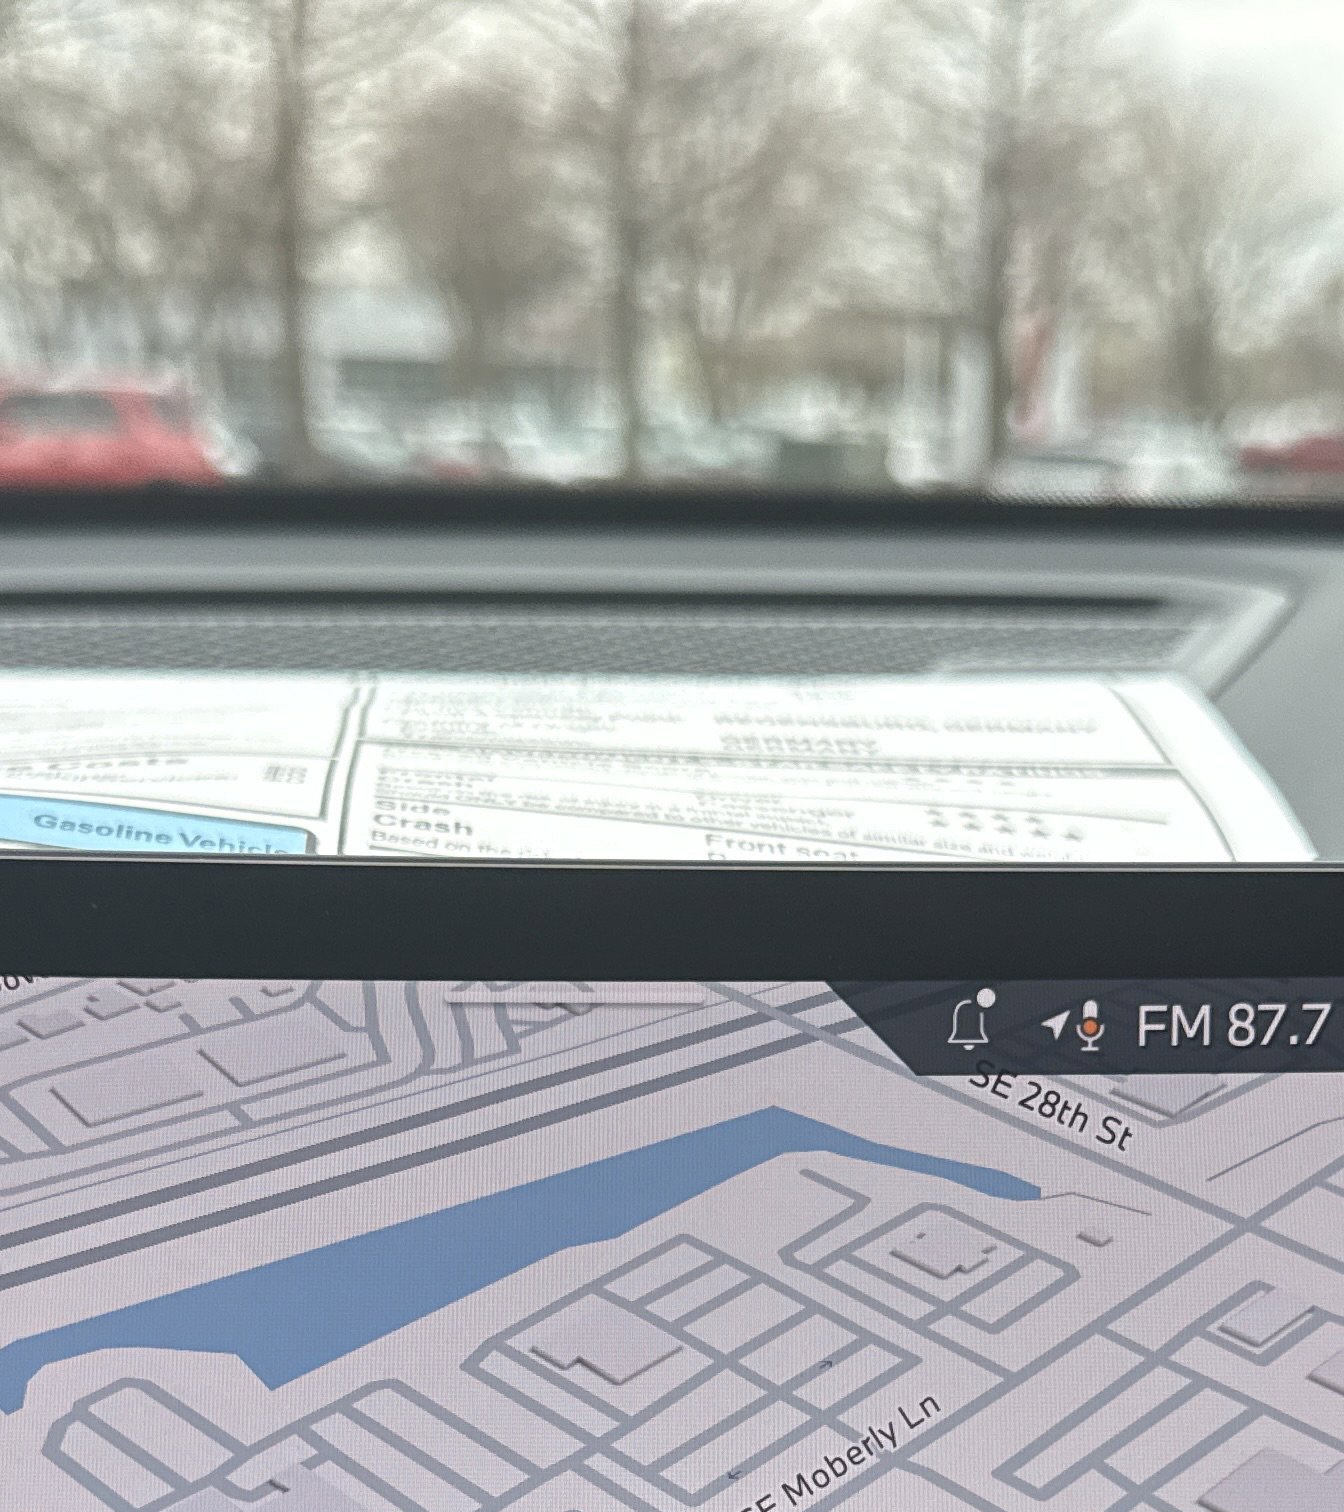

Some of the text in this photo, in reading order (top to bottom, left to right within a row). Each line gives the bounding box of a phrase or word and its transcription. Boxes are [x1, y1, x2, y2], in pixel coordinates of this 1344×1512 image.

[375, 799, 451, 817] Side
[33, 813, 174, 845] Gasoline
[373, 813, 474, 836] Crash
[370, 829, 439, 850] Based
[445, 839, 471, 854] on
[705, 833, 787, 856] Front
[1137, 1002, 1333, 1047] FM 87.7
[968, 1059, 1135, 1152] SE 28th St
[781, 1421, 898, 1506] Moberly
[897, 1395, 942, 1430] Ln
